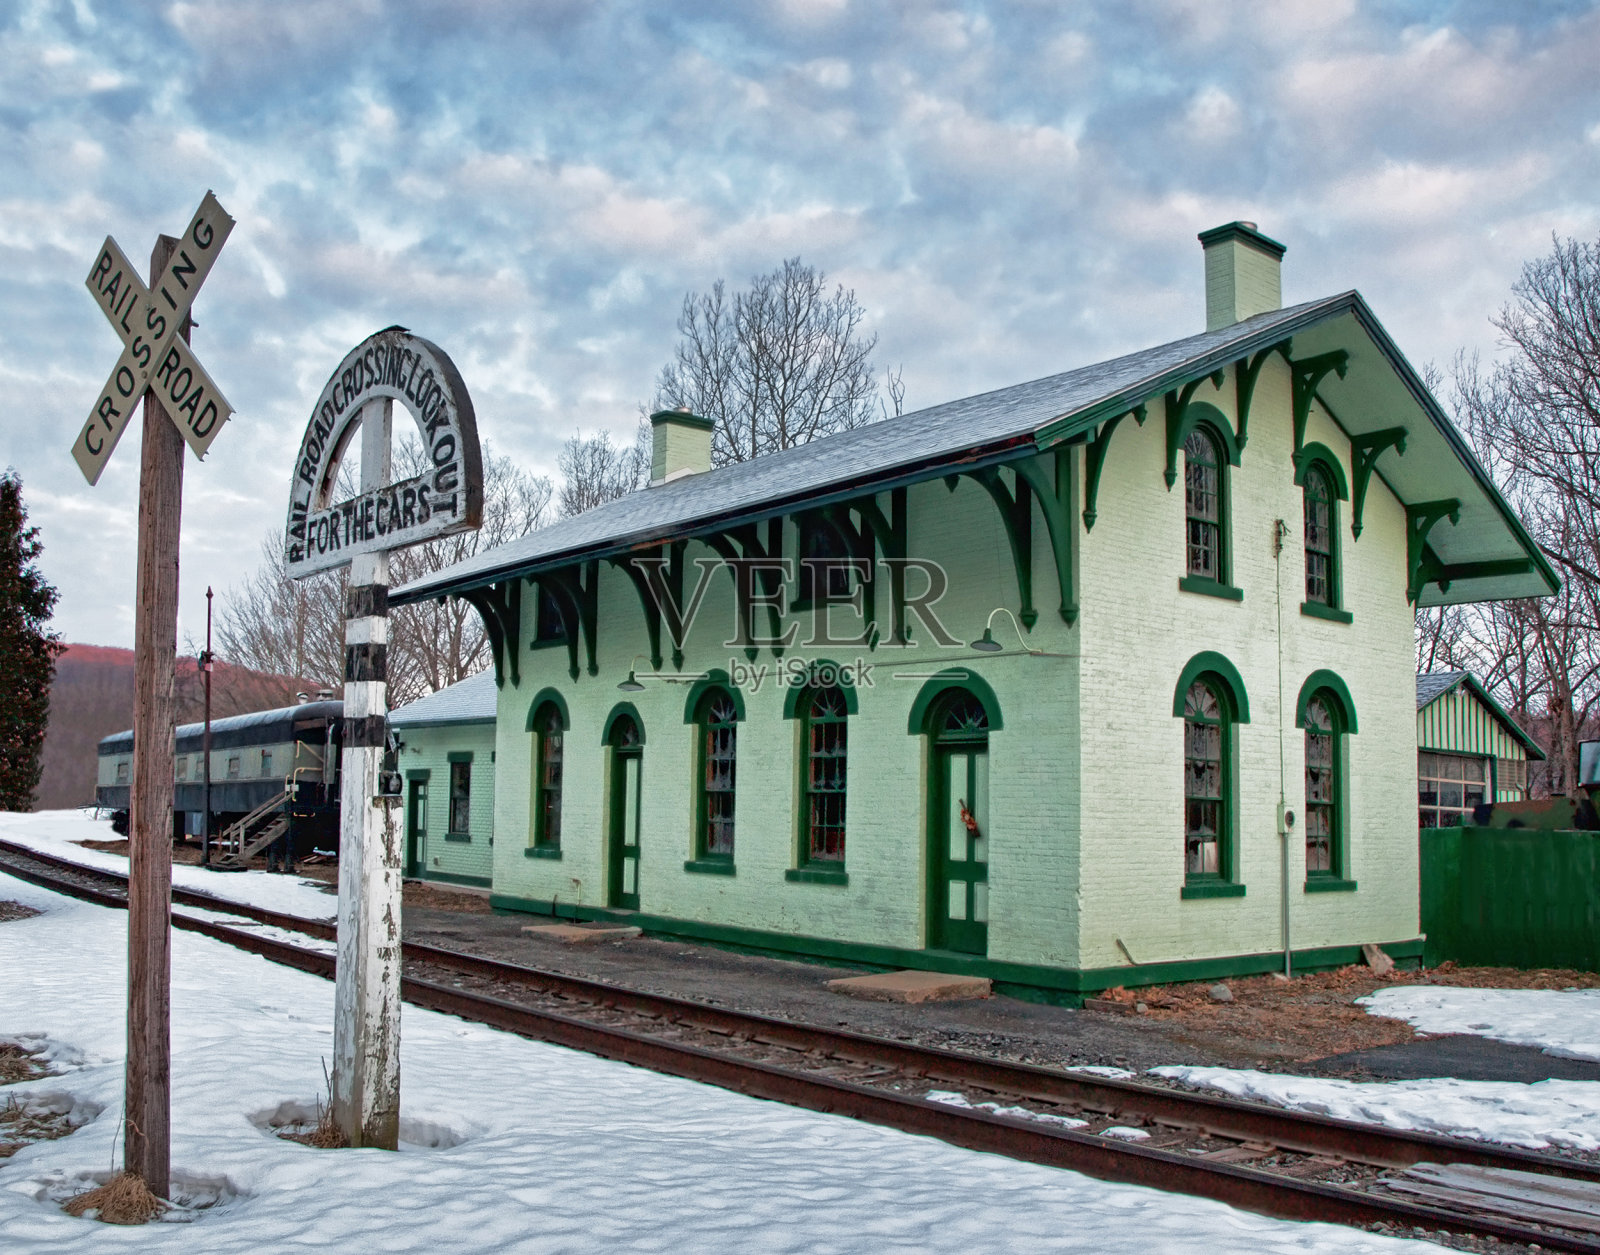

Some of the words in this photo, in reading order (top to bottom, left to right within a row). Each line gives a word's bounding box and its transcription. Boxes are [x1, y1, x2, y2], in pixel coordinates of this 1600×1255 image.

[85, 218, 214, 456] CROSSING
[91, 250, 139, 335] RAIL
[156, 345, 218, 439] ROAD
[289, 491, 311, 563] RAIL
[300, 399, 336, 486] ROAD
[332, 345, 411, 415] CROSSING
[404, 353, 451, 447] LOOK
[432, 433, 458, 518] OUT
[306, 511, 342, 559] FOR
[342, 499, 375, 547] THE
[375, 484, 432, 535] CARS
